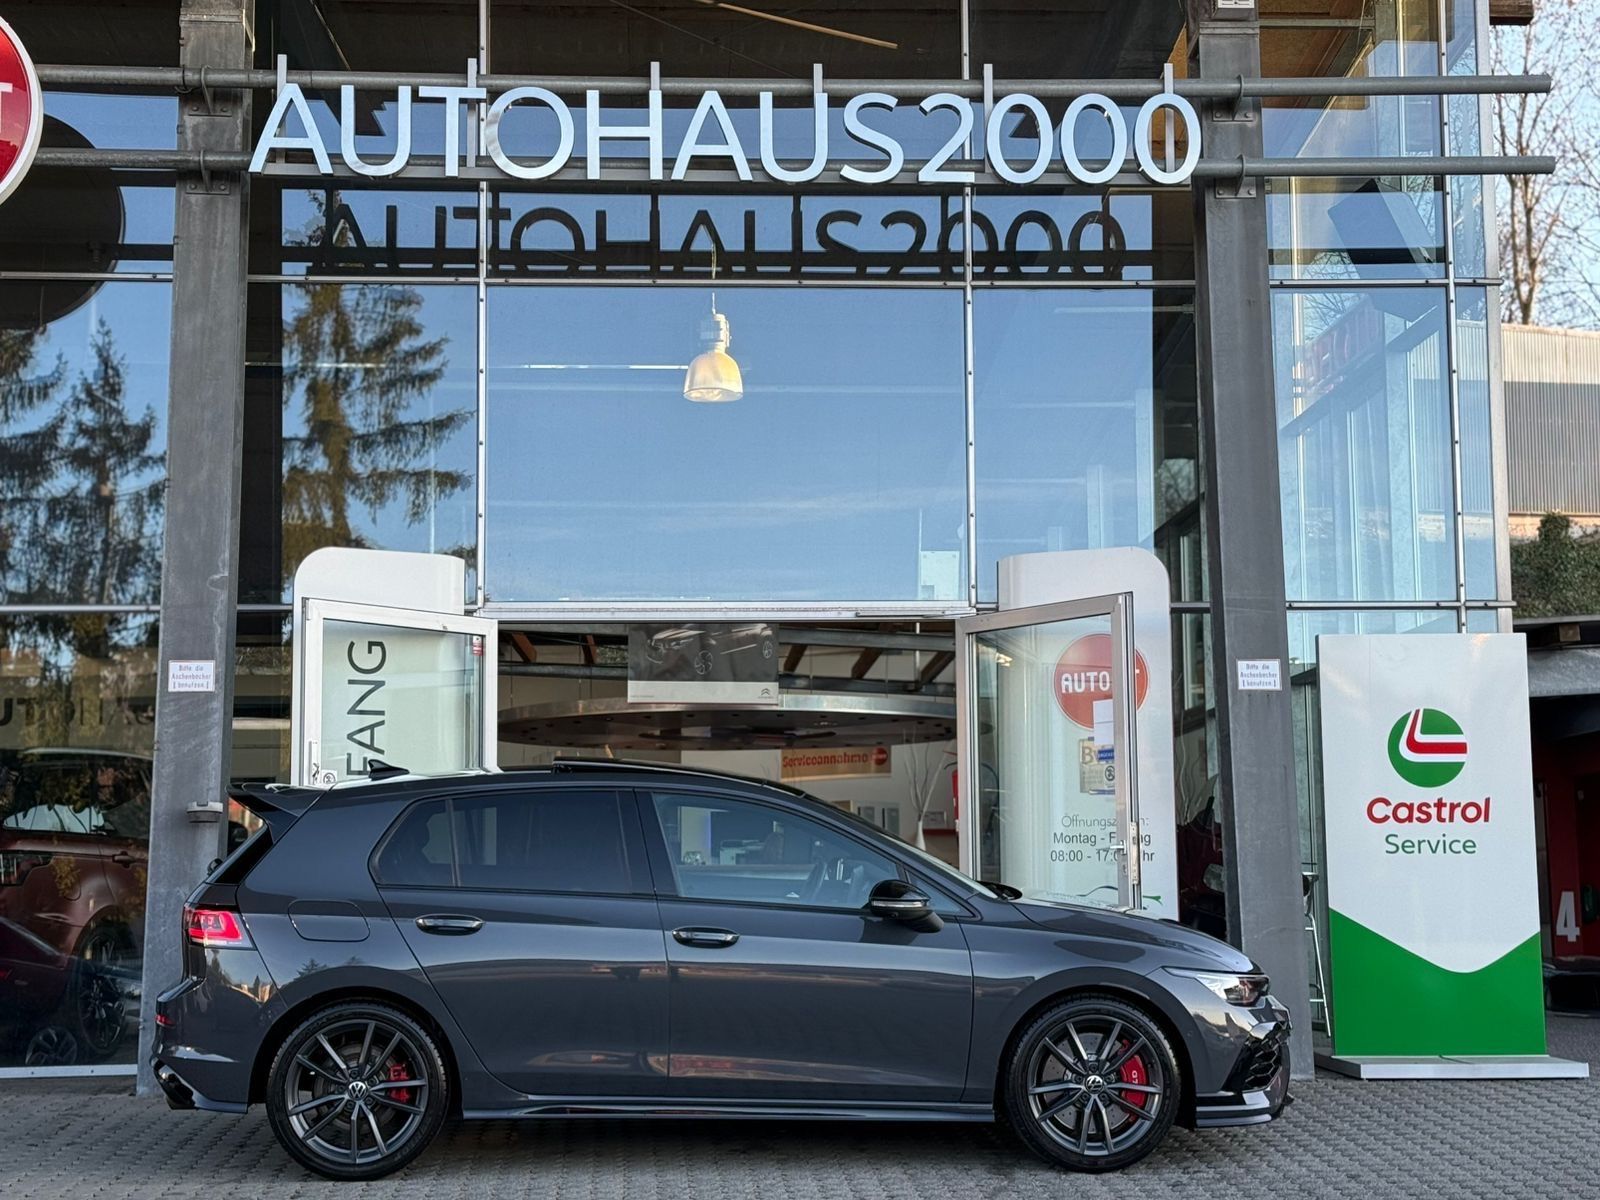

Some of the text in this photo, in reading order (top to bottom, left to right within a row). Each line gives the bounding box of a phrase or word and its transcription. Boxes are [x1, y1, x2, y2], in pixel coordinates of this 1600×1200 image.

[248, 82, 1202, 186] AUTOHAUS2000
[1061, 669, 1140, 694] AUTO
[1366, 796, 1491, 825] Castrol
[1053, 831, 1097, 847] Montag
[1384, 833, 1478, 855] Service
[1050, 849, 1084, 862] 08:00
[1555, 890, 1581, 943] 4
